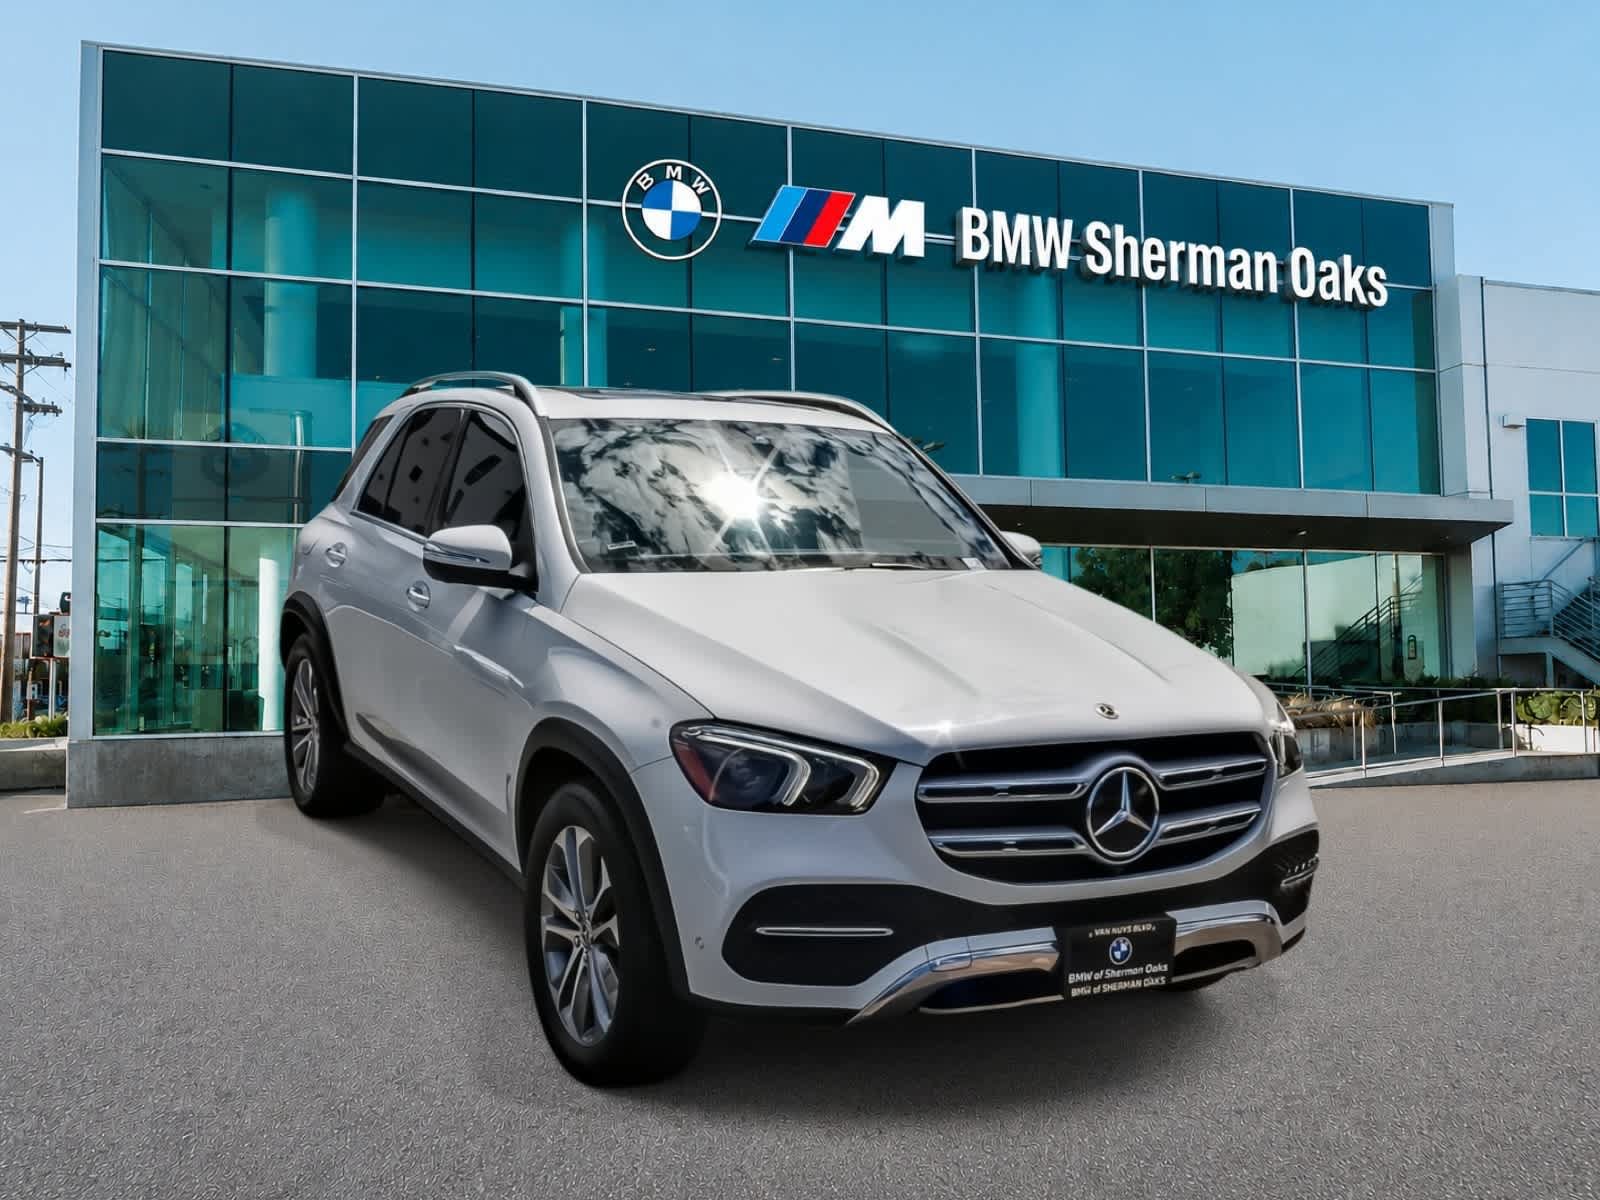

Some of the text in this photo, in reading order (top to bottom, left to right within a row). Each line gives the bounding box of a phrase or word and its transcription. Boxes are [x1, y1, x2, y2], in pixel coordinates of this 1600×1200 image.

[636, 165, 711, 196] BMW
[835, 195, 925, 258] M
[960, 206, 1389, 308] BMW Sherman Oaks
[1094, 927, 1111, 937] VAN
[1068, 963, 1169, 984] BMW of Sherman Oaks
[1071, 976, 1167, 997] BMW of SHERMAN OAKS
